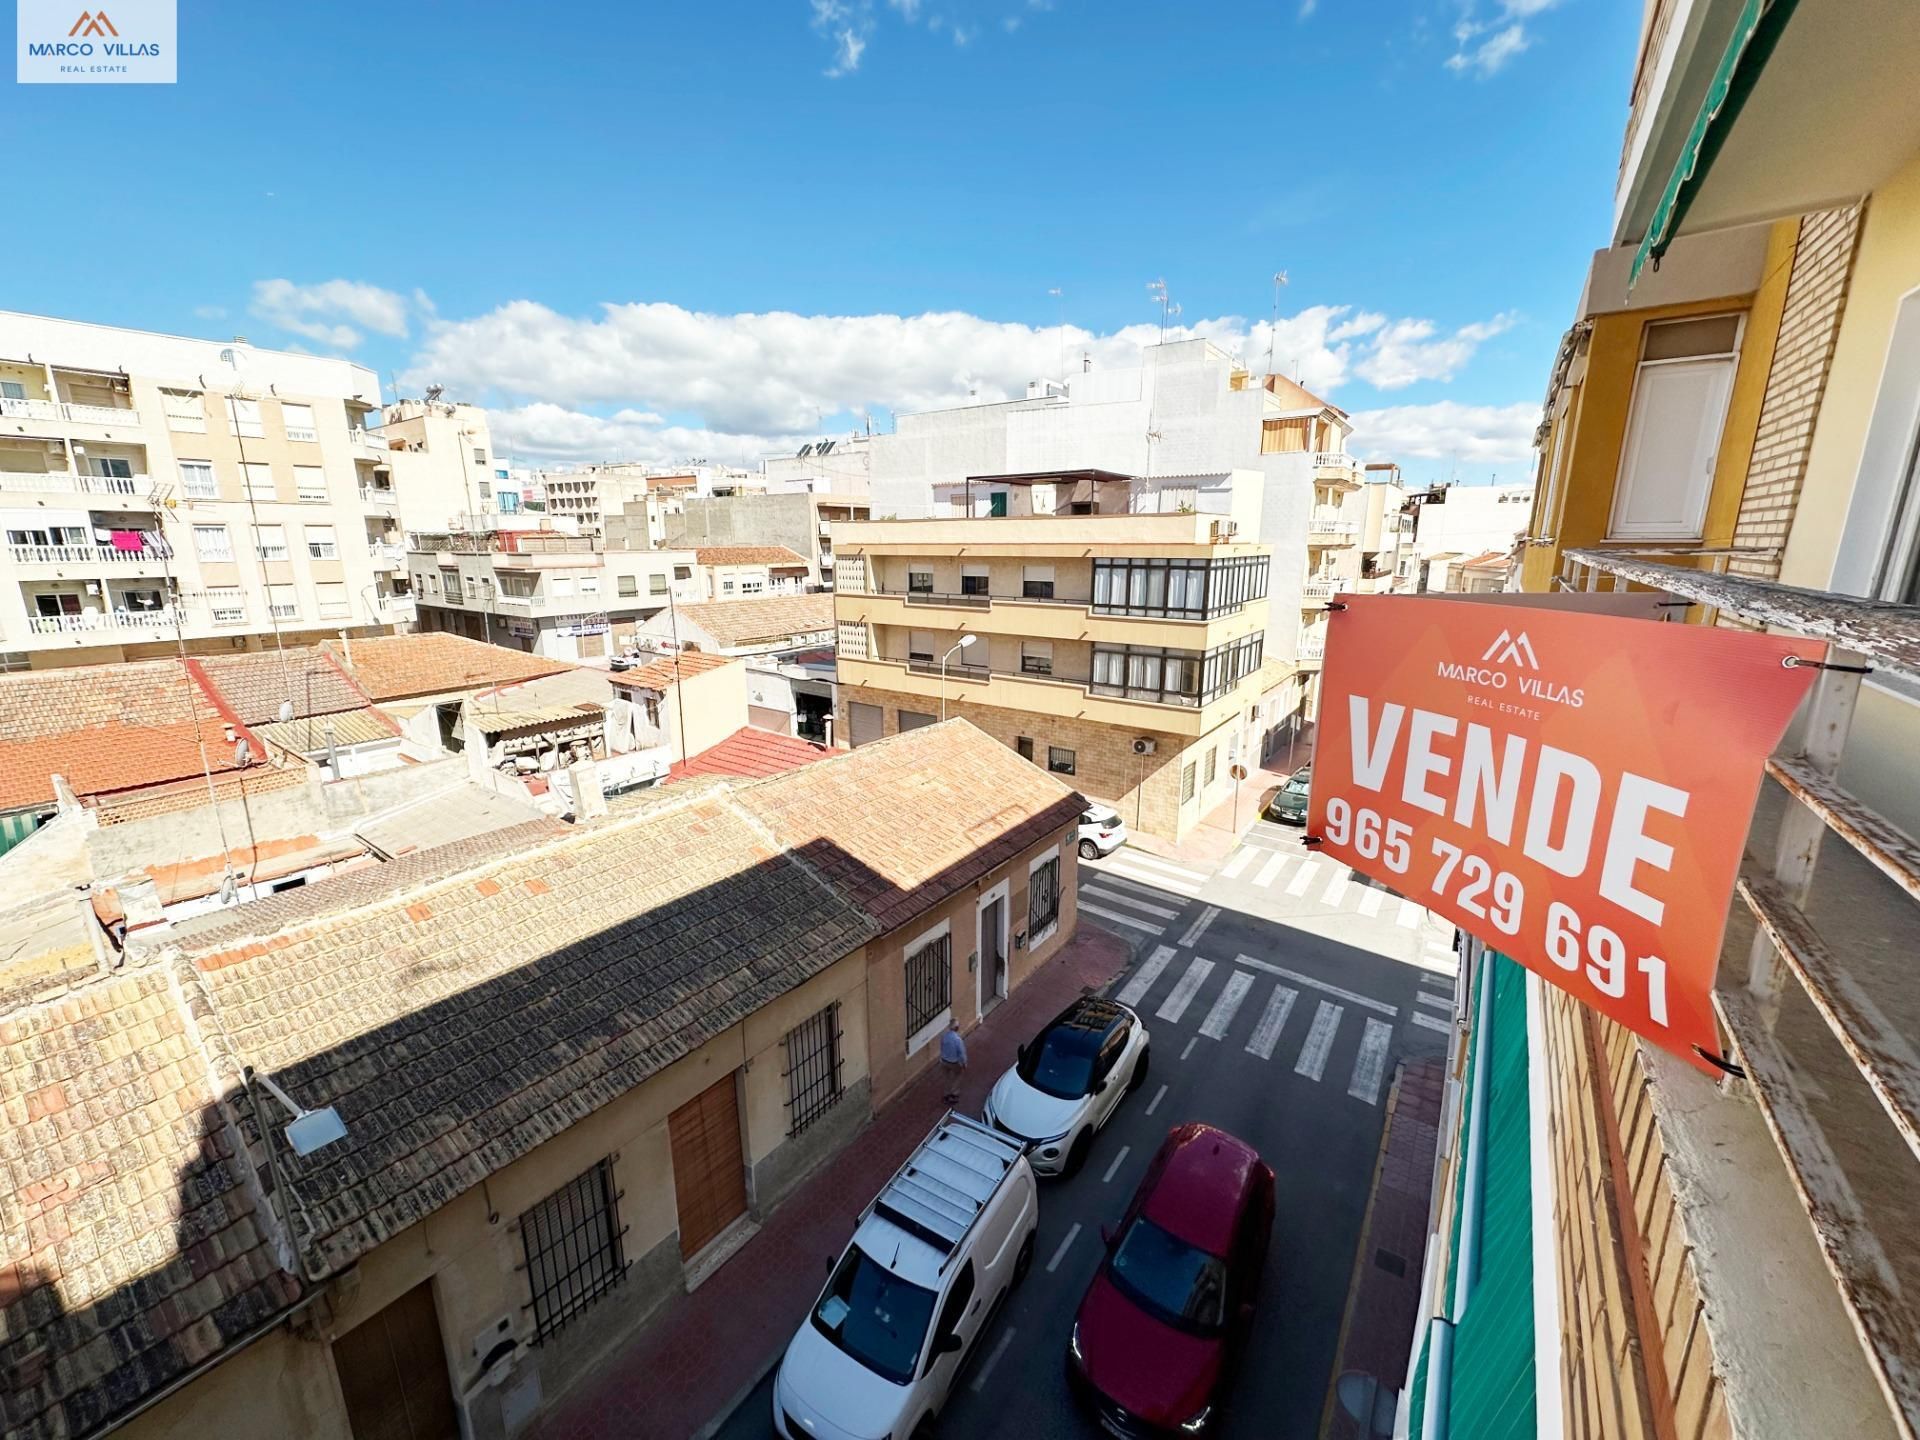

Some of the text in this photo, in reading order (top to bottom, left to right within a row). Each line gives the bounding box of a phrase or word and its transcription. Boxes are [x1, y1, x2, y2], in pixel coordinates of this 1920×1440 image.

[1437, 661, 1585, 708] MARCO VILLAS
[1467, 695, 1541, 721] REAL ESTATE
[1349, 694, 1690, 927] VENDE
[1325, 797, 1669, 1028] 965 729 691
